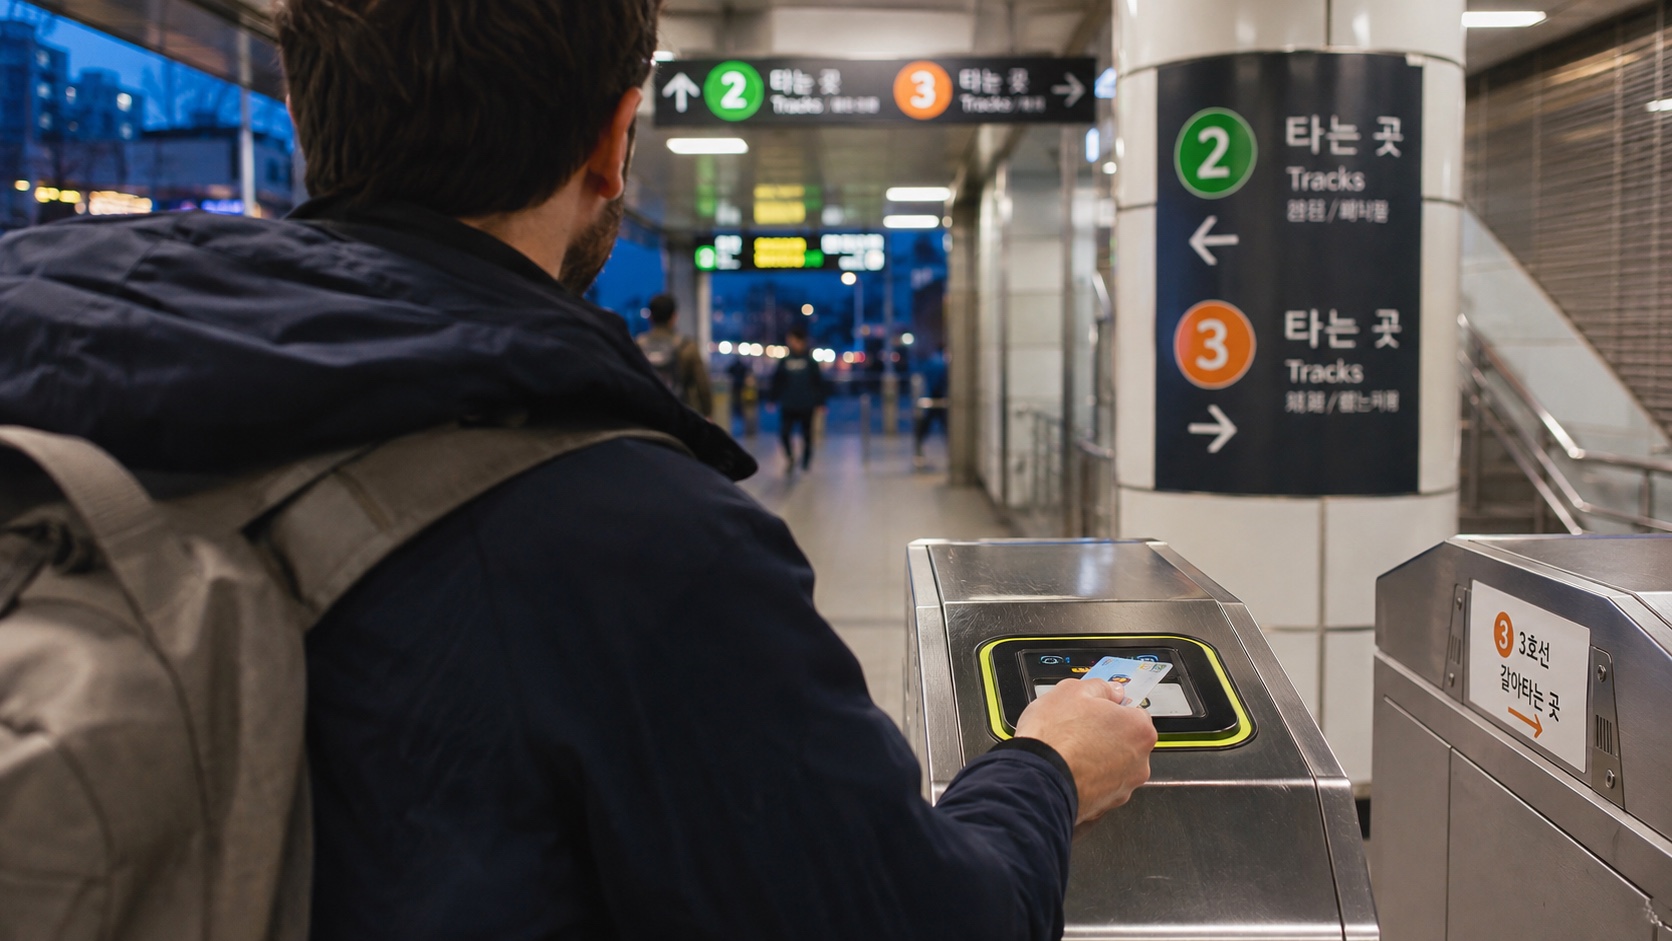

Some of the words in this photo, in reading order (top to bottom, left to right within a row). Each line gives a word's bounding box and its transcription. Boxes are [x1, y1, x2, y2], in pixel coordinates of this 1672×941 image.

[720, 70, 748, 110] 2
[769, 68, 815, 95] 타는
[909, 69, 937, 110] 3
[958, 67, 1003, 94] 타는
[1197, 125, 1231, 180] 2
[1285, 113, 1361, 156] 타는
[1372, 115, 1404, 158] 곳
[1286, 165, 1366, 192] Tracks
[1195, 318, 1229, 371] 3
[1284, 308, 1360, 349] 타는
[1372, 308, 1402, 350] 곳
[1284, 357, 1364, 384] Tracks
[1498, 619, 1509, 650] 3
[1518, 631, 1550, 670] 3호선
[1500, 663, 1544, 713] 갈아타는
[1548, 691, 1560, 723] 곳
